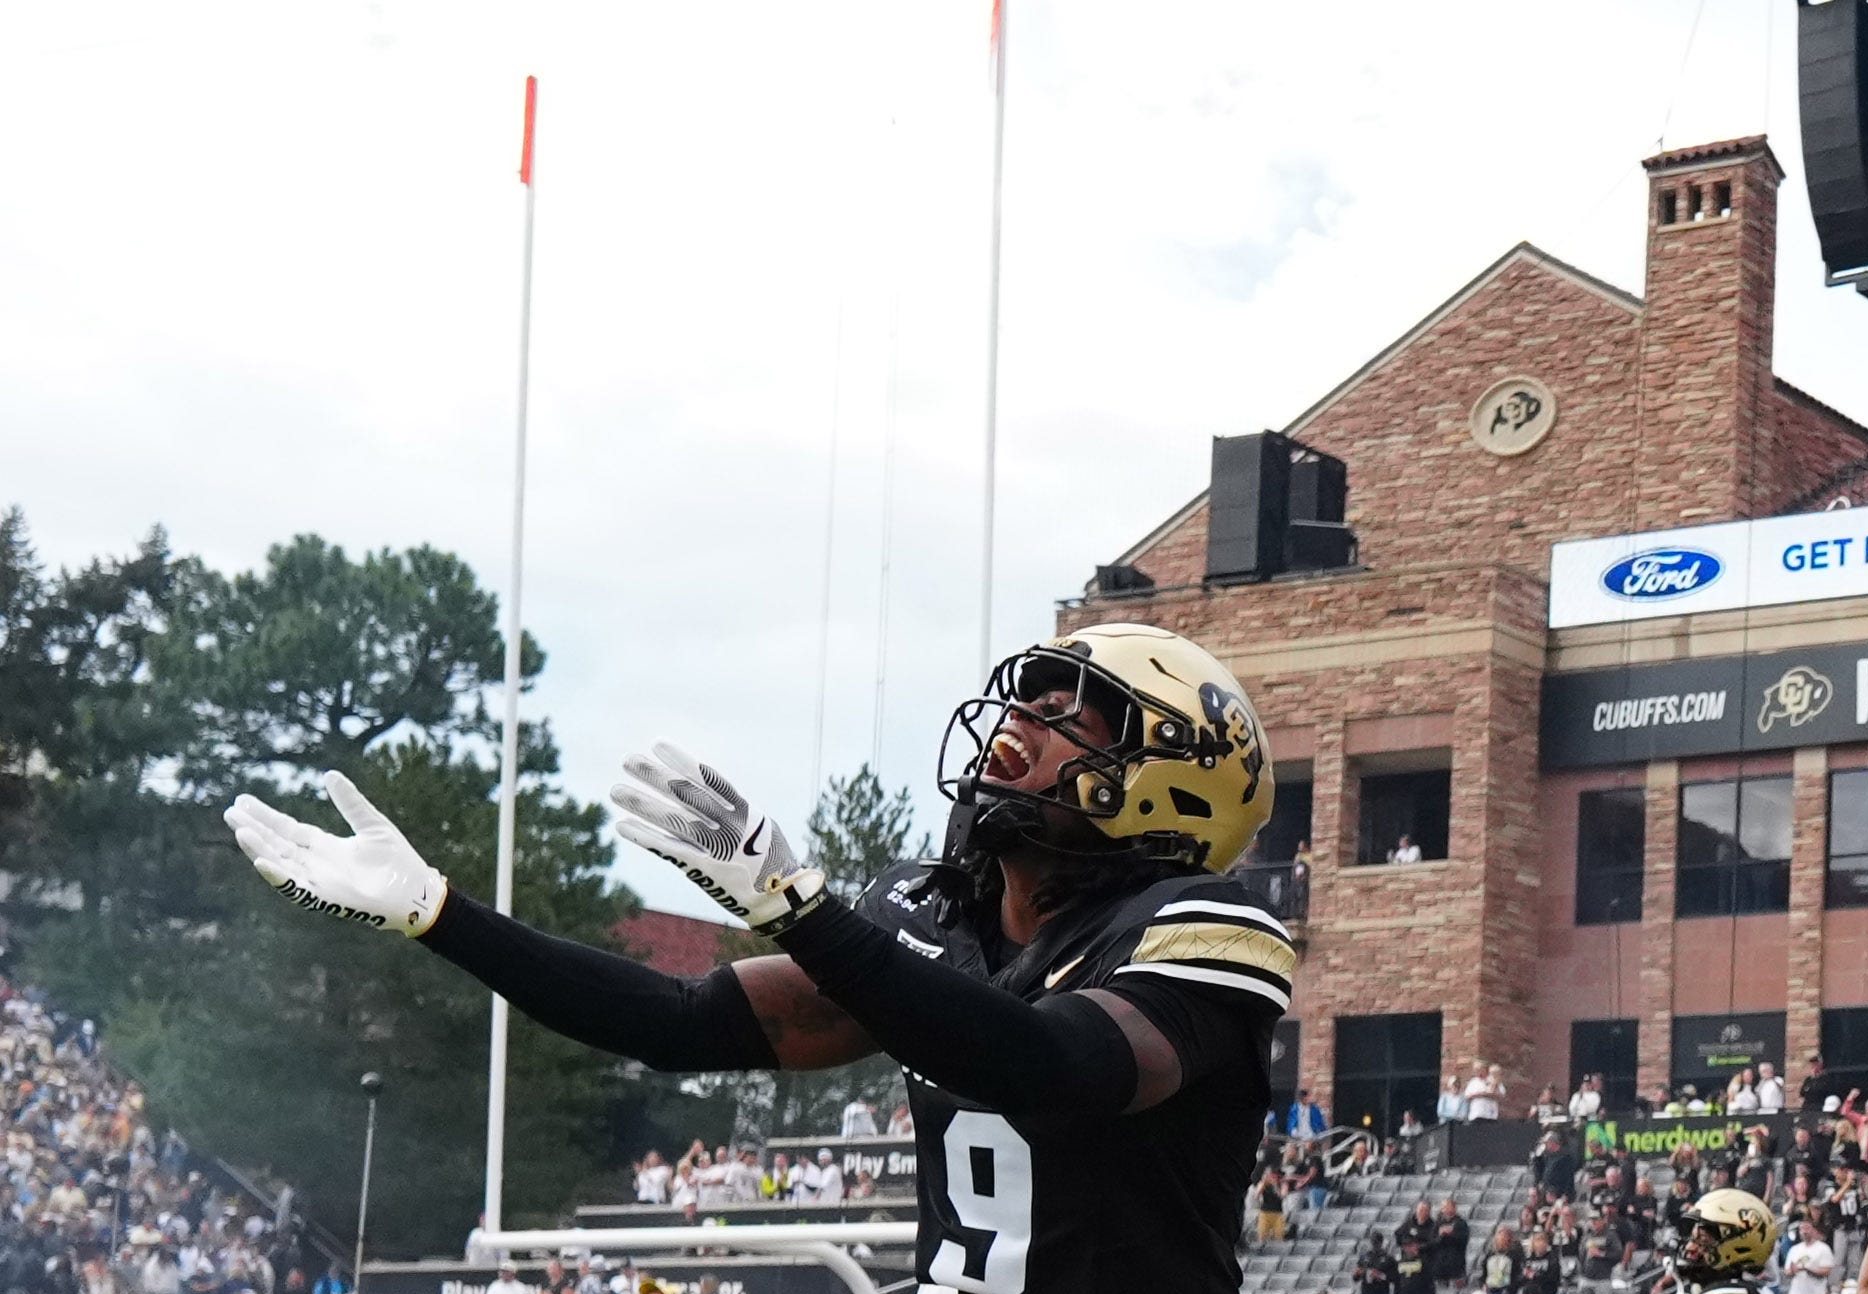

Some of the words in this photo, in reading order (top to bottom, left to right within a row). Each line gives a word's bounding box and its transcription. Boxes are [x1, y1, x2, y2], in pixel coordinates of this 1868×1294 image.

[1624, 553, 1701, 596] Ford
[1783, 538, 1853, 572] GET
[1593, 690, 1727, 732] CUBUFFS.COM
